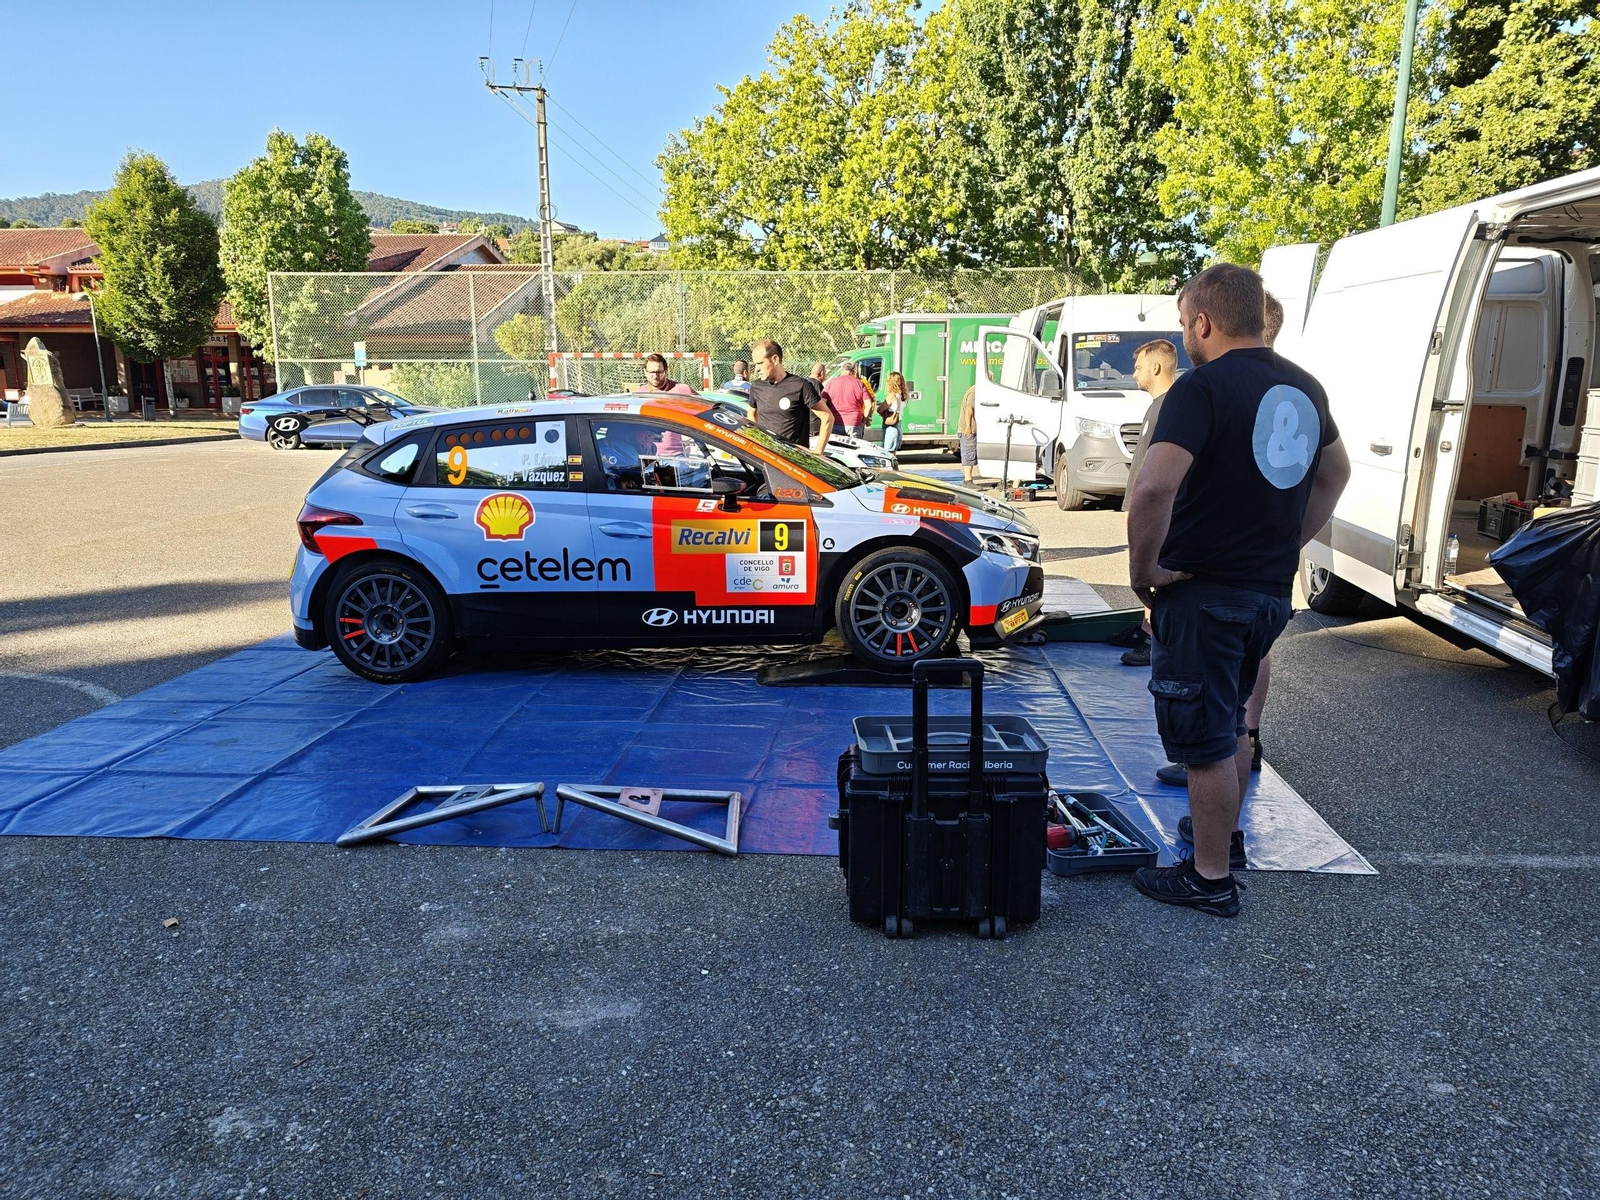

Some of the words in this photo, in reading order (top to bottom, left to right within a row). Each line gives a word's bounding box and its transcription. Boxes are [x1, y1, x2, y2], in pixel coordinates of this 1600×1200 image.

[447, 445, 468, 485] 9
[912, 506, 963, 521] HYUNDAI
[678, 528, 751, 546] Recalvi
[774, 523, 789, 550] 9
[476, 547, 632, 589] cetelem
[683, 609, 775, 624] HYUNDAI
[948, 760, 970, 769] Raci
[984, 760, 1013, 769] Iberia
